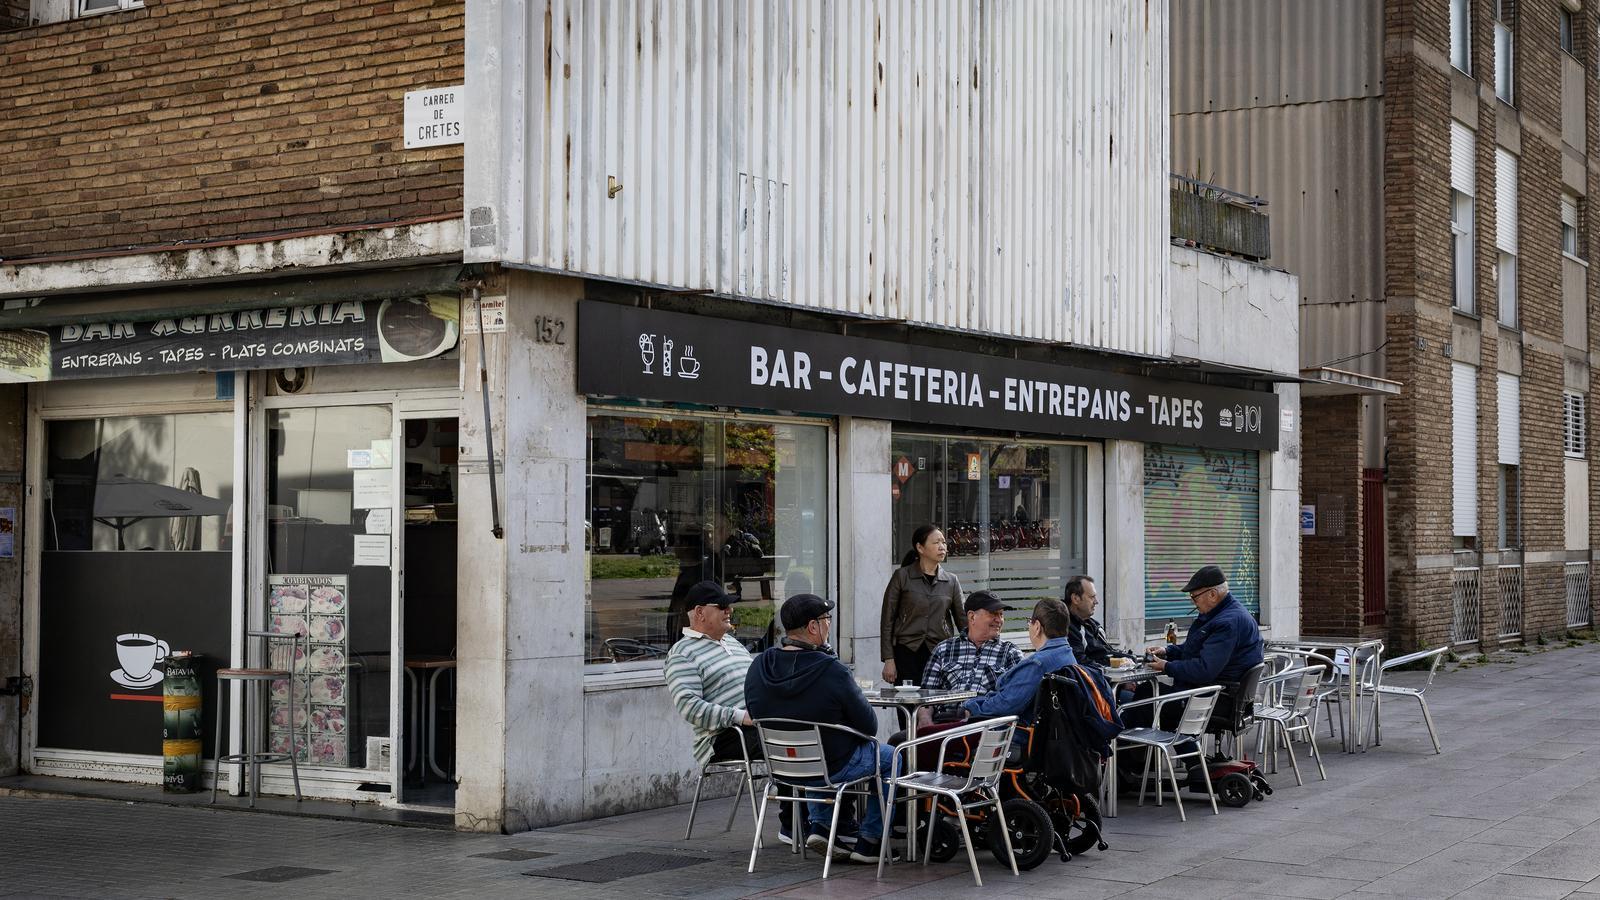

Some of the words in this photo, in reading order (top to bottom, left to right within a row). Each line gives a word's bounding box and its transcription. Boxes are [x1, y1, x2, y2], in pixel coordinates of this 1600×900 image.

[423, 93, 455, 106] CARRER
[433, 109, 444, 120] DE
[418, 121, 460, 140] CRETES
[534, 315, 566, 345] 152
[61, 351, 143, 369] ENTREPANS
[159, 347, 205, 364] TAPES
[221, 343, 266, 360] PLATS
[271, 337, 366, 356] COMBINATS
[750, 345, 812, 391] BAR
[839, 356, 984, 408] CAFETERIA
[1004, 377, 1131, 422] ENTREPANS
[1148, 394, 1204, 430] TAPES
[282, 576, 333, 585] COMBINADOS
[166, 667, 195, 677] BATAVIA
